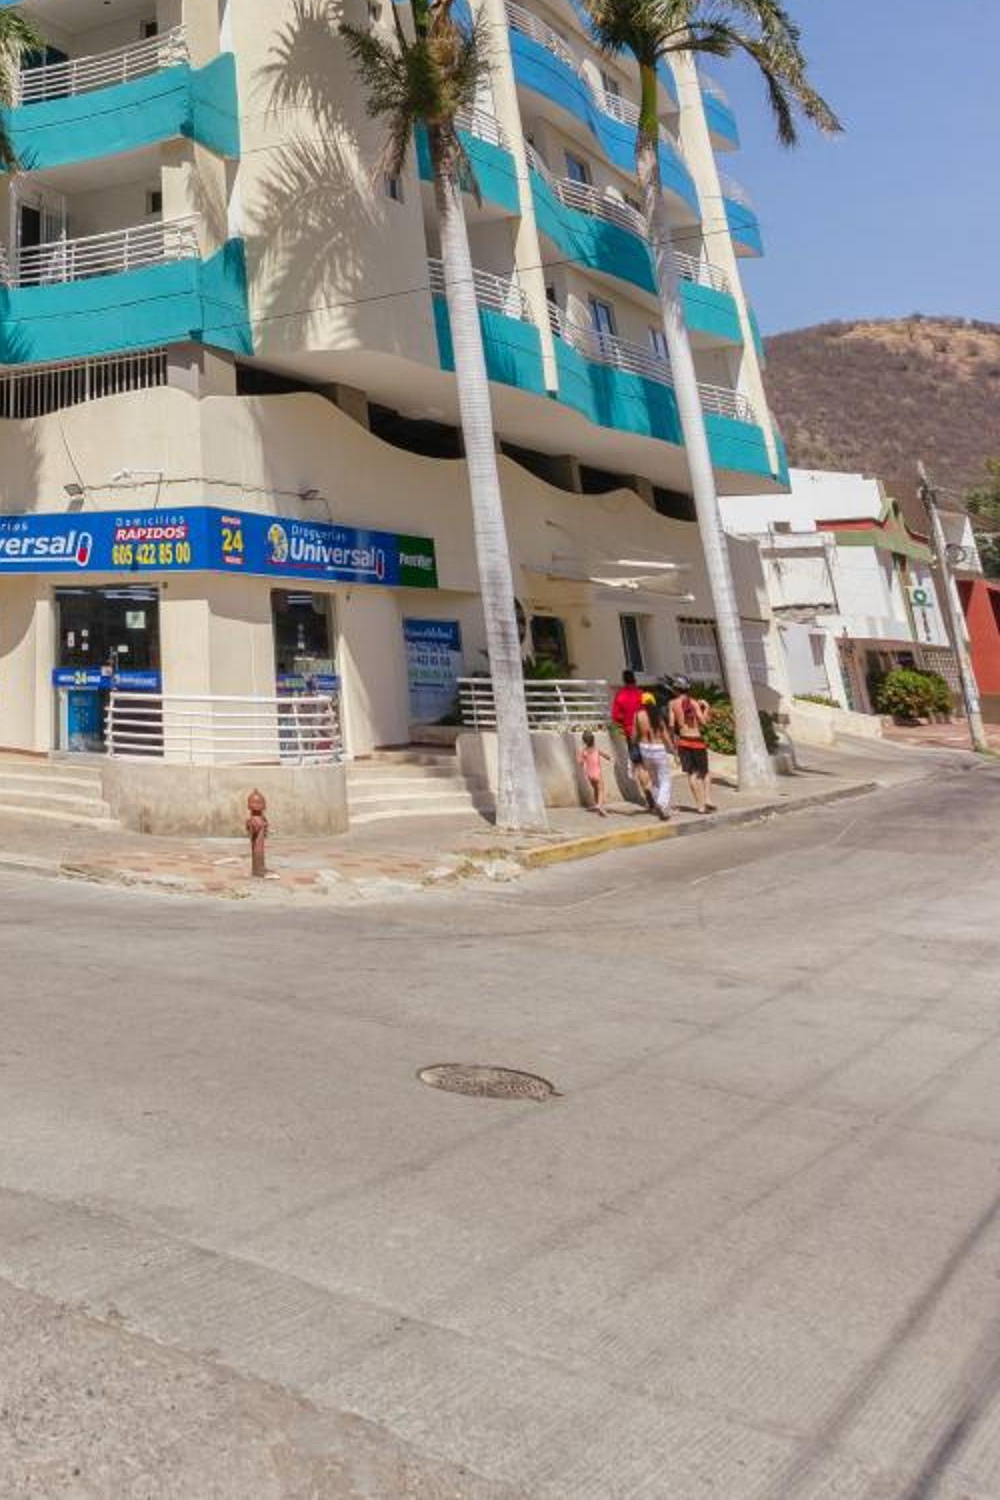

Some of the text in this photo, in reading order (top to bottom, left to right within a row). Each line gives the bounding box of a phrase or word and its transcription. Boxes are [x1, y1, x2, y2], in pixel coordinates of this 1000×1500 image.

[115, 515, 185, 526] Domicilios
[115, 526, 185, 541] RAPIDOS
[221, 528, 243, 552] 24
[135, 543, 156, 564] 422
[175, 541, 191, 563] 00
[290, 537, 376, 567] Universal
